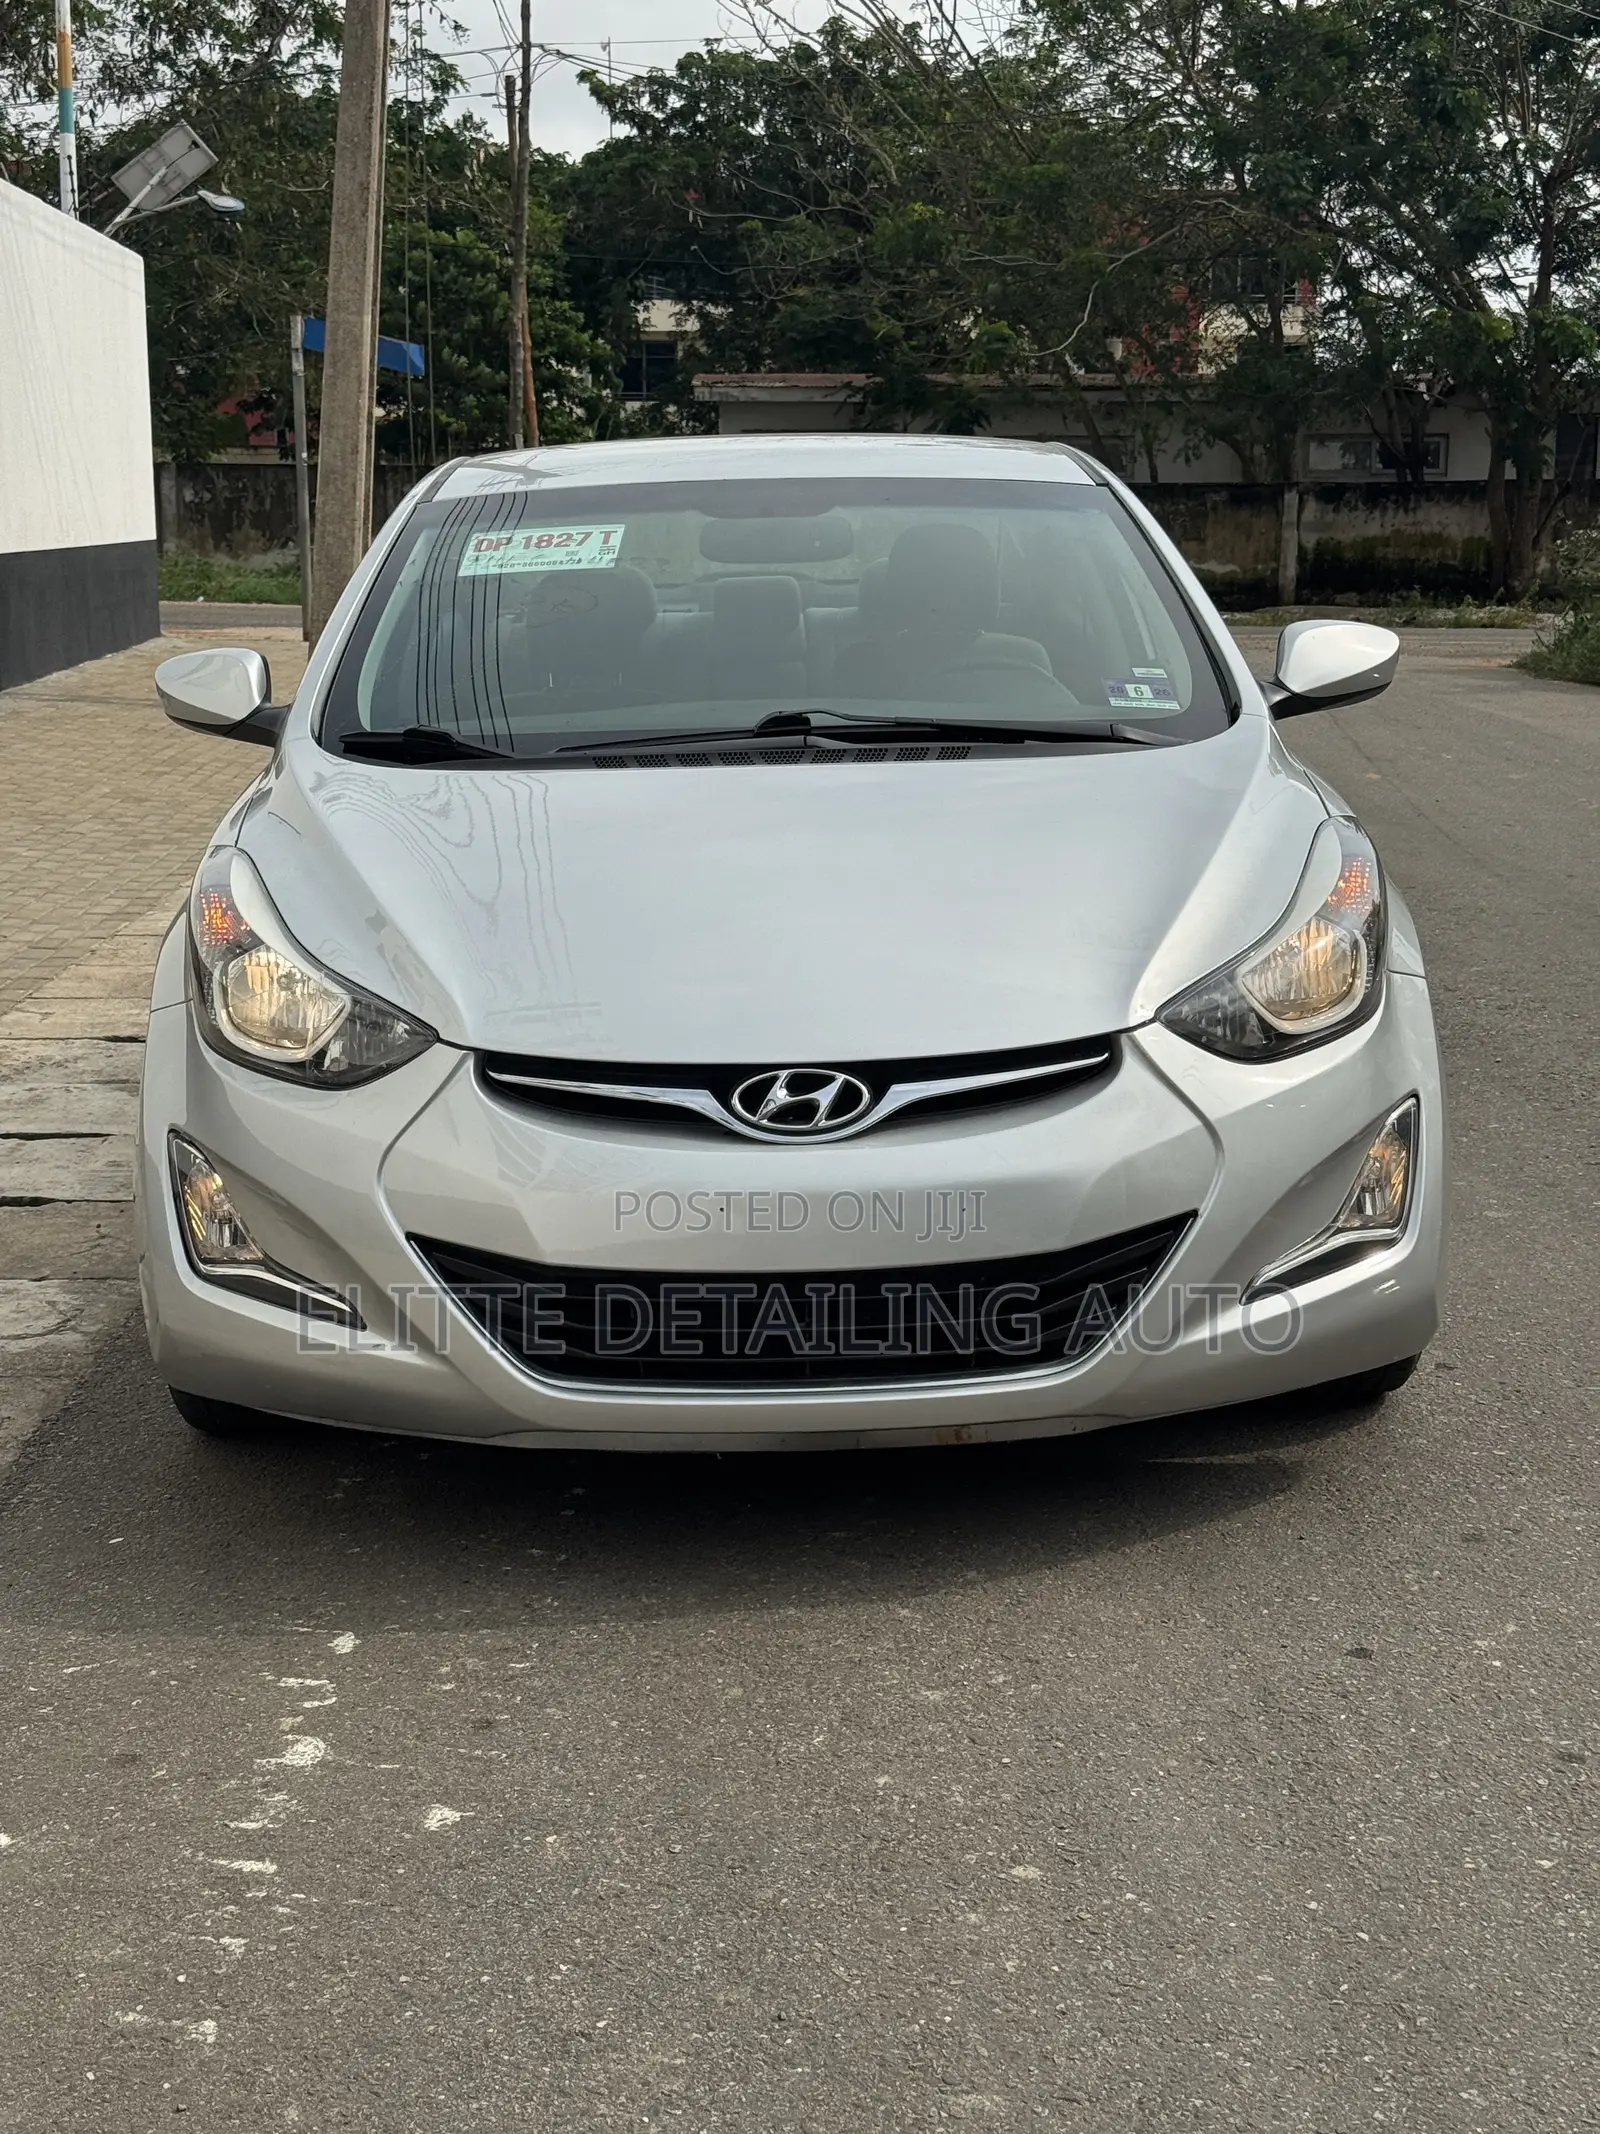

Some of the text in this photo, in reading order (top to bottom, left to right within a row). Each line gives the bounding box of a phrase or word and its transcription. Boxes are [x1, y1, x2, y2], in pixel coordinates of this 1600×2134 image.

[473, 530, 618, 552] DP 1827 T
[1133, 686, 1144, 697] 6
